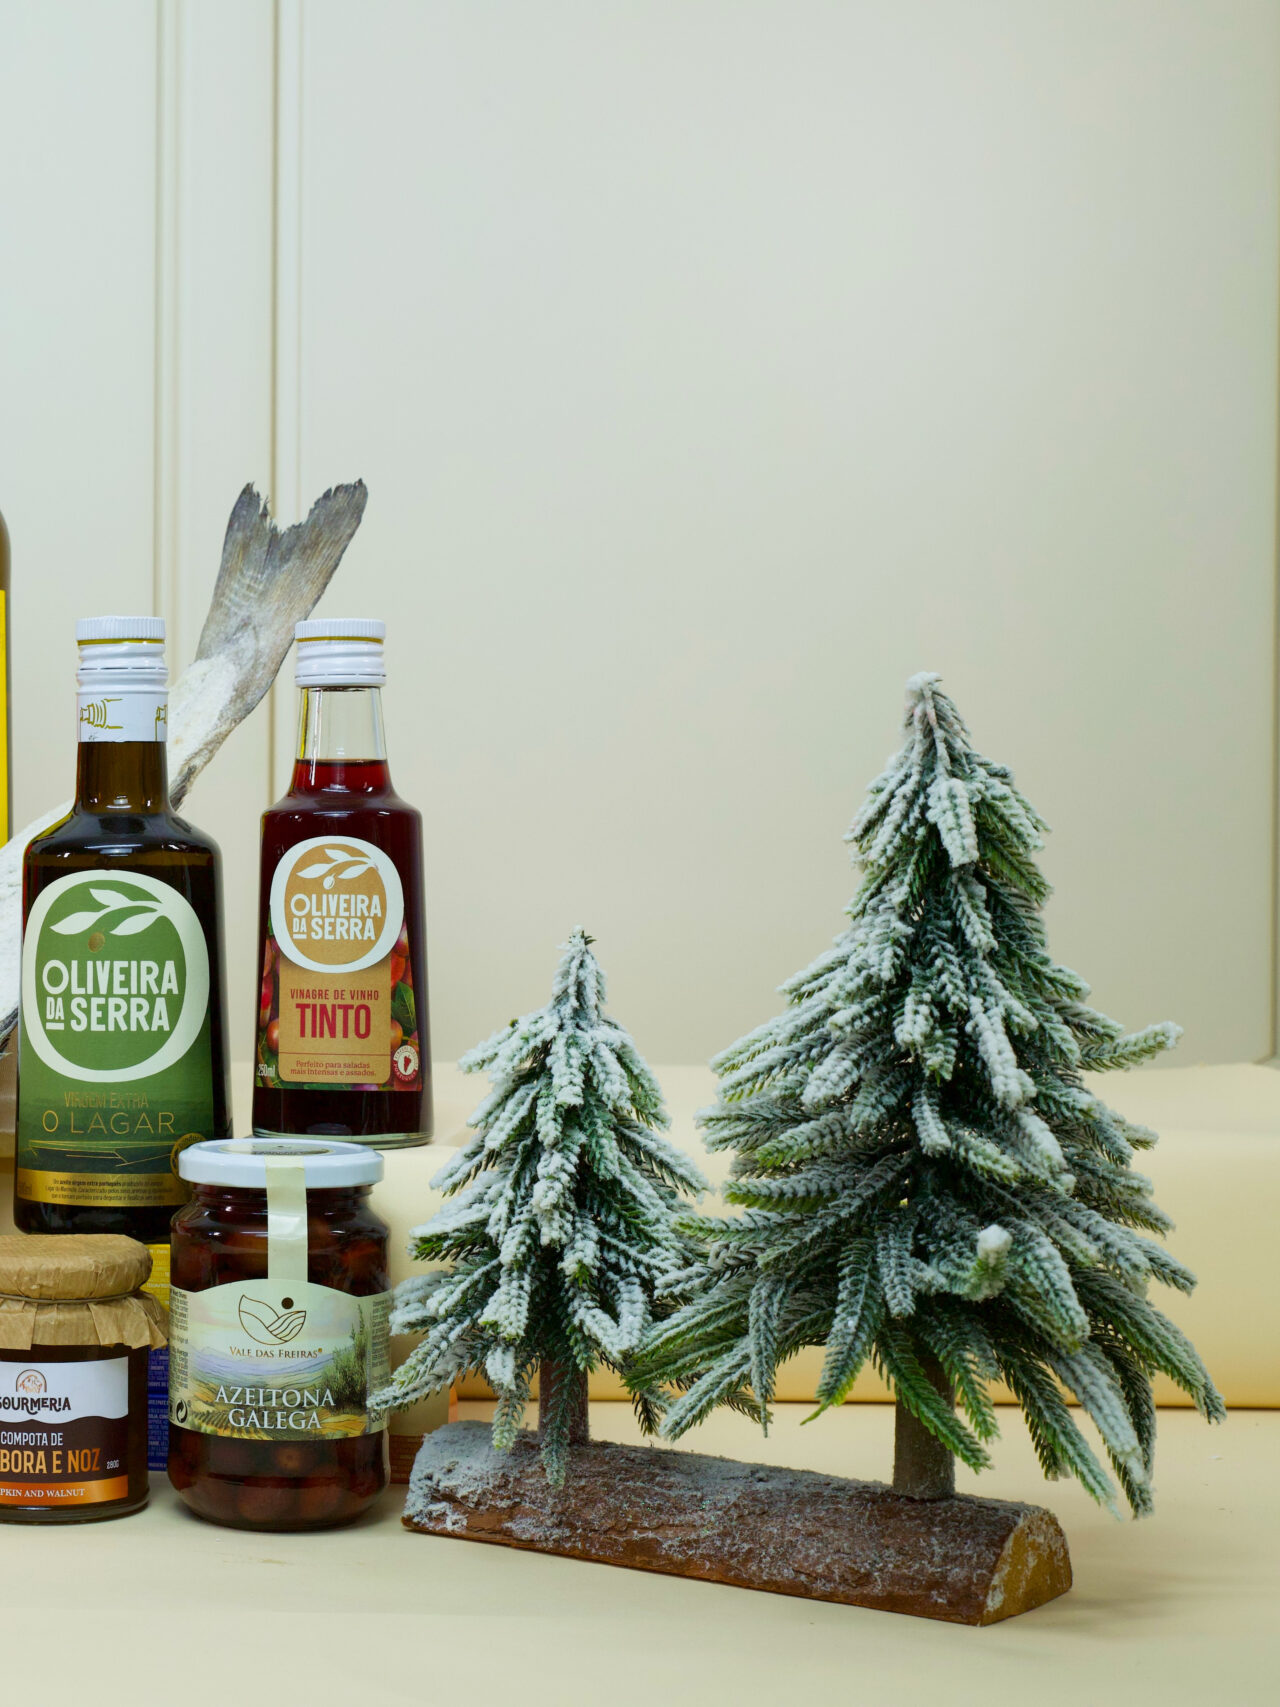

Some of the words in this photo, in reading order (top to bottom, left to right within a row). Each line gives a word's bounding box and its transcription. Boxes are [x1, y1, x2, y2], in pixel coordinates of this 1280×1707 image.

[290, 893, 382, 917] OLIVEIRA
[293, 918, 307, 933] DA
[311, 918, 376, 940] SERRA
[42, 959, 179, 995] OLIVEIRA
[290, 989, 329, 1000] VINAGRE
[334, 989, 346, 1000] DE
[350, 990, 379, 1000] VINHO
[46, 997, 65, 1021] DA
[70, 997, 170, 1032] SERRA
[296, 1003, 371, 1039] TINTO
[296, 1060, 323, 1068] Perfeito
[343, 1061, 370, 1069] saladas
[64, 1091, 106, 1108] VIRGEM
[110, 1092, 149, 1109] EXTRA
[42, 1110, 59, 1133] O
[71, 1111, 175, 1134] LAGAR
[229, 1345, 252, 1357] VALE
[255, 1348, 274, 1359] DAS
[215, 1384, 336, 1408] AZEITONA
[228, 1408, 322, 1430] GALEGA
[0, 1431, 49, 1446] COMPOTA
[50, 1432, 64, 1446] DE
[52, 1450, 63, 1474] E
[67, 1447, 101, 1474] NOZ
[24, 1487, 44, 1498] AND
[46, 1487, 86, 1498] WALNUT
